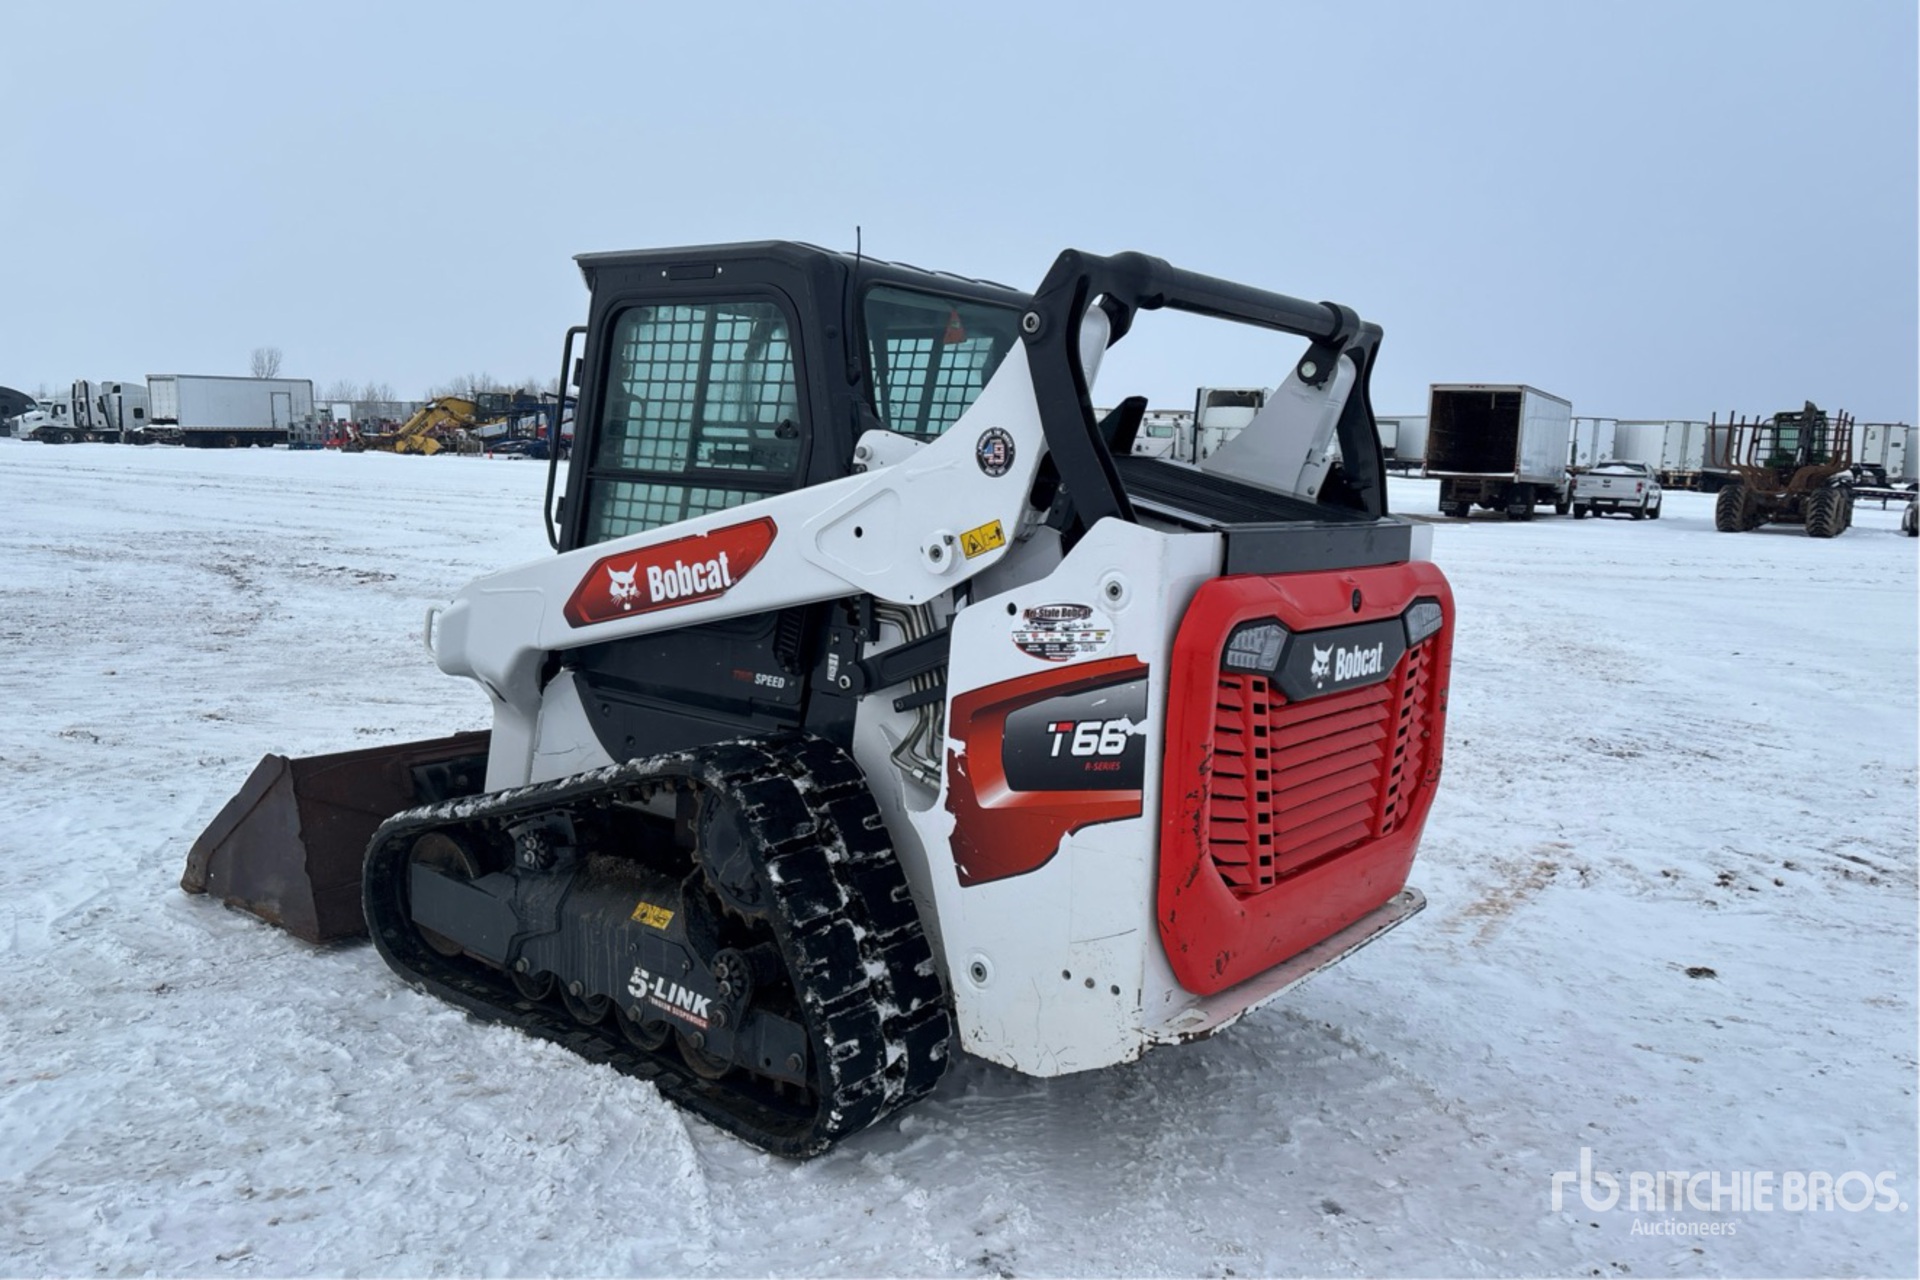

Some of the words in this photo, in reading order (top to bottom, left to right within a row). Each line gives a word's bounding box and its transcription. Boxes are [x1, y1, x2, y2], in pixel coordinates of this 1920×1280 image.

[646, 551, 732, 603] Bobcat
[1061, 607, 1092, 619] Bobcat
[1335, 642, 1383, 682] Bobcat
[754, 672, 785, 689] SPEED
[1047, 721, 1127, 757] T66
[1085, 761, 1121, 771] R-SERIES
[627, 966, 712, 1019] 5-LINK
